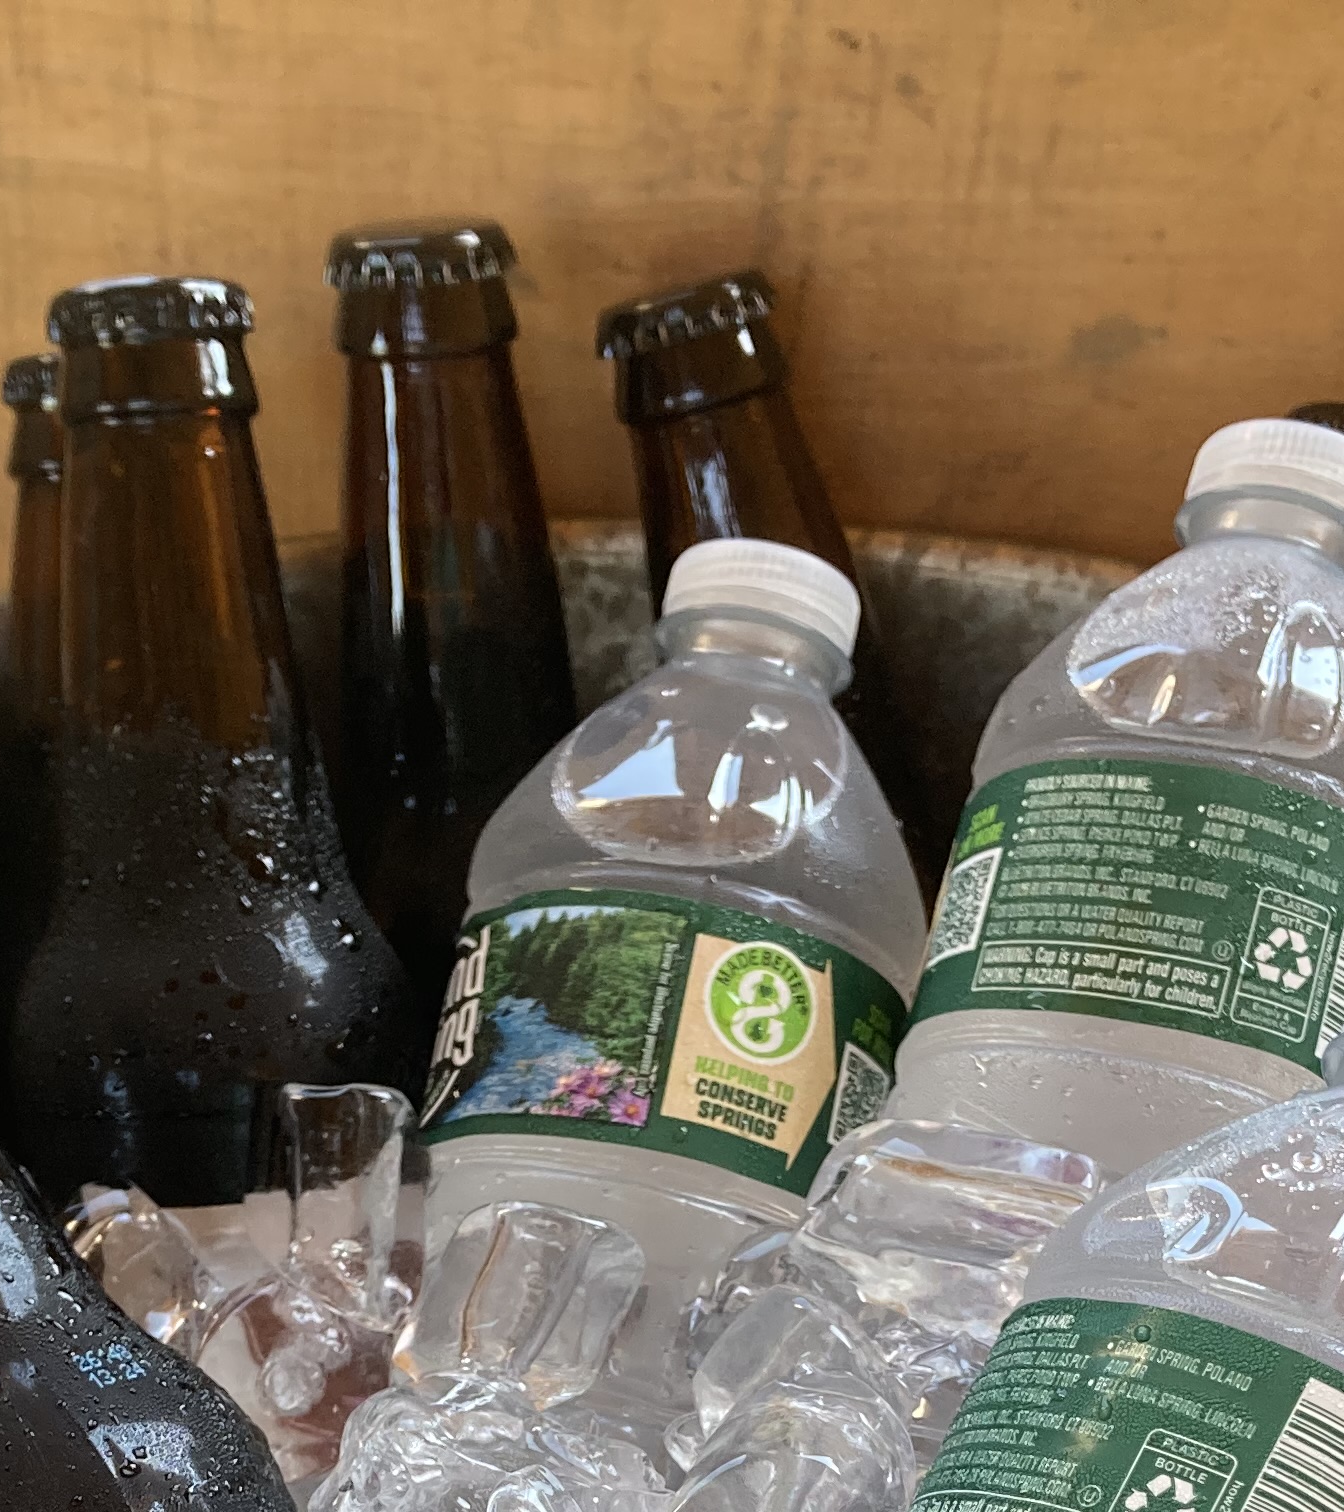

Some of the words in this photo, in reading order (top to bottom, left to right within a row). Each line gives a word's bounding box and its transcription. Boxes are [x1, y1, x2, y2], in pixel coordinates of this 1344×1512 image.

[1272, 894, 1320, 920] PLASTIC
[1270, 912, 1314, 937] BOTTLE
[716, 950, 758, 986] MADE
[1058, 948, 1070, 965] is
[1082, 951, 1118, 969] small
[1117, 955, 1144, 973] part
[1145, 959, 1171, 978] and
[1171, 965, 1208, 986] poses
[1209, 973, 1220, 989] a
[1071, 972, 1142, 998] particularly
[1143, 980, 1163, 998] for
[694, 1055, 770, 1093] HELPING
[773, 1080, 795, 1103] TO
[694, 1077, 789, 1123] CONSERVE
[697, 1100, 778, 1141] SPRINGS
[1201, 1362, 1253, 1392] POLAND
[1160, 1437, 1221, 1467] PLASTIC
[1154, 1457, 1209, 1485] BOTTLE
